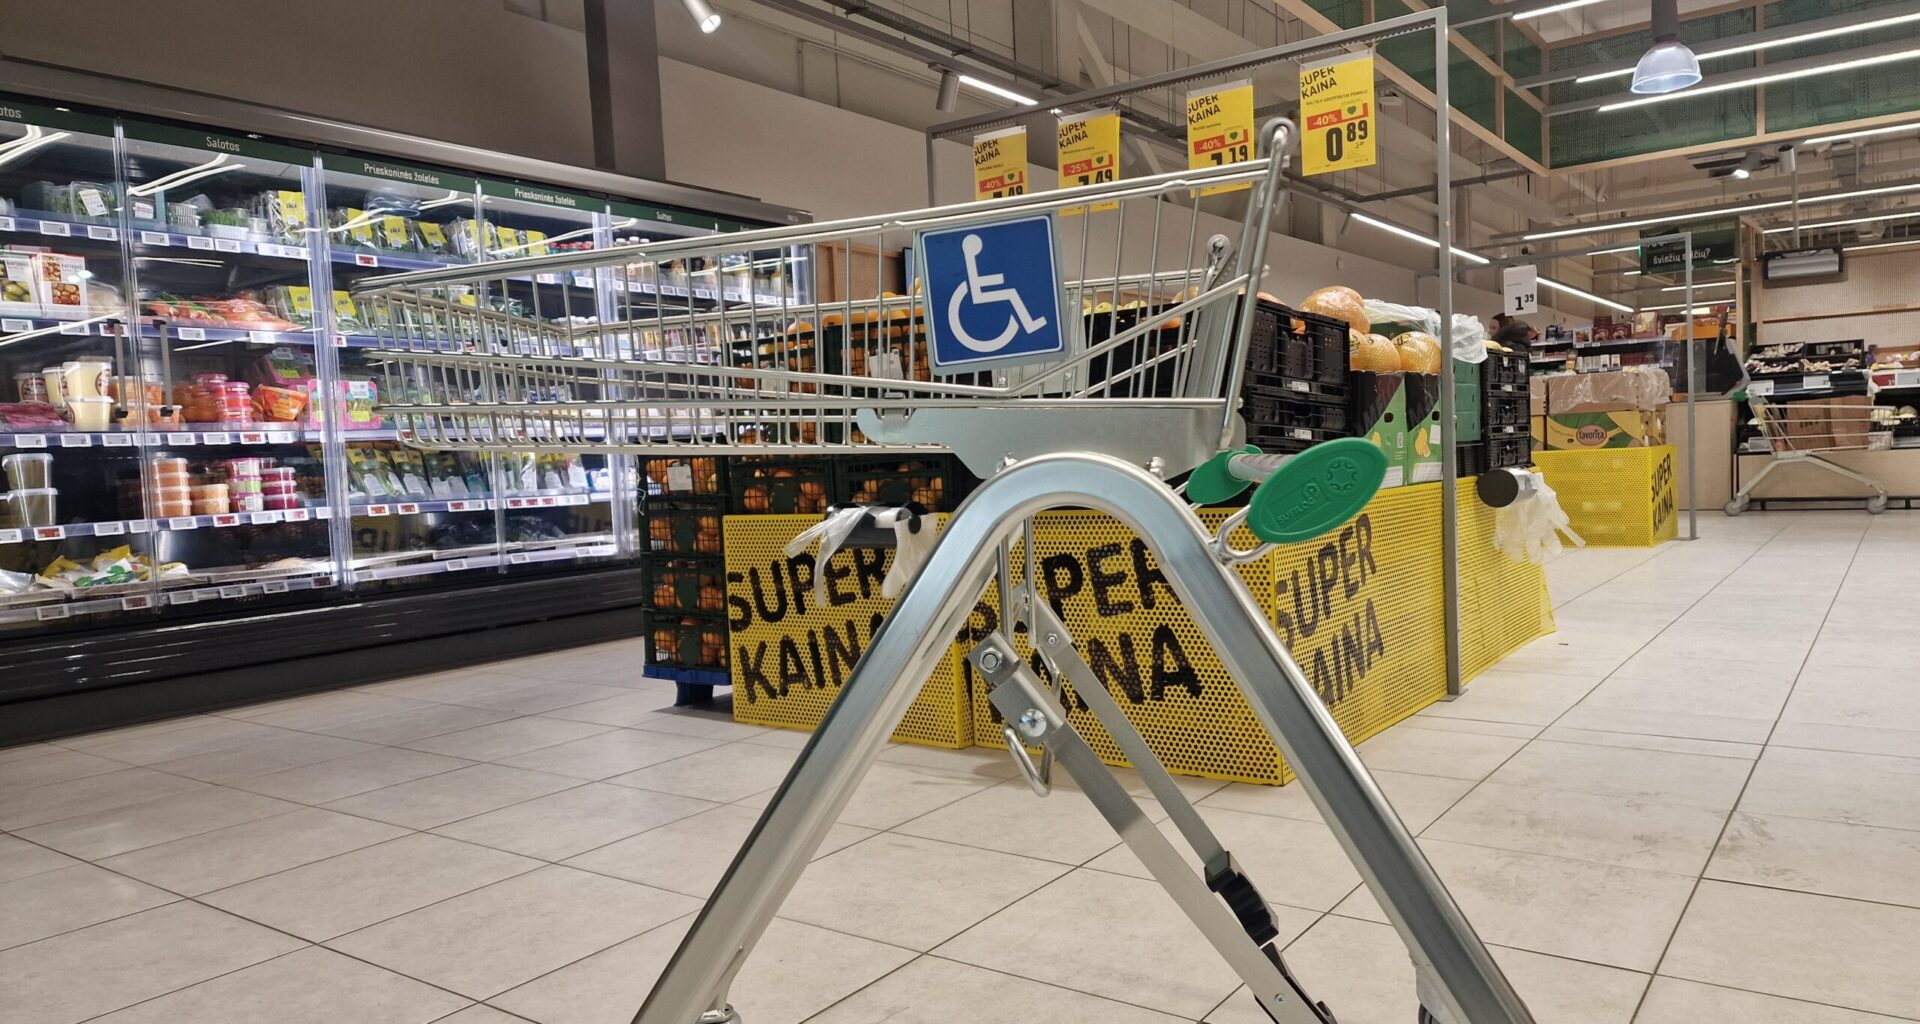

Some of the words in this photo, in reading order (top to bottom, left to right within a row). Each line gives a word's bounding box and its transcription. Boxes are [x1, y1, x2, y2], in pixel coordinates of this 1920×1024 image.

[1302, 77, 1337, 99] KAINA
[1188, 104, 1221, 125] KAINA
[1313, 113, 1337, 126] -40%
[206, 136, 240, 152] Salotos
[1059, 130, 1089, 149] KAINA
[974, 147, 1000, 167] KAINA
[363, 162, 413, 182] Prieskoninės
[414, 170, 440, 186] žolelės
[1653, 486, 1674, 536] KAINA
[1300, 598, 1385, 707] AINA
